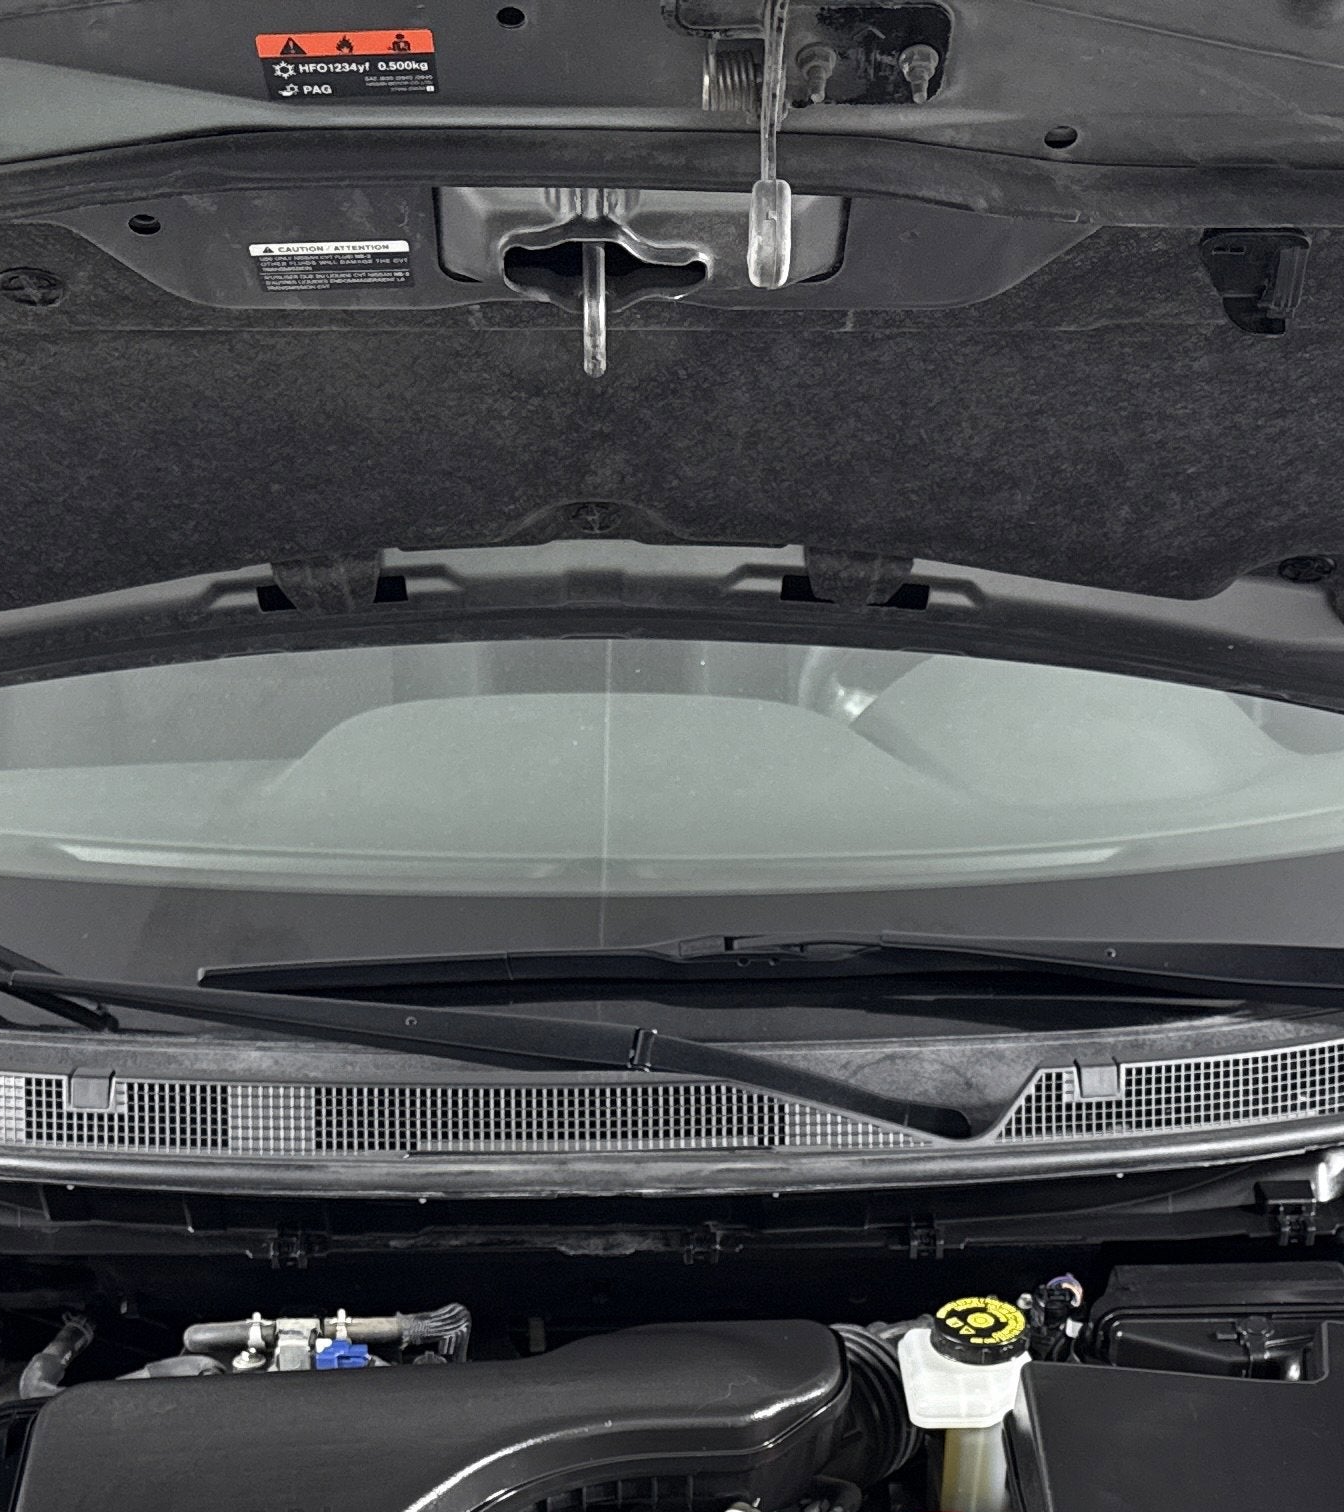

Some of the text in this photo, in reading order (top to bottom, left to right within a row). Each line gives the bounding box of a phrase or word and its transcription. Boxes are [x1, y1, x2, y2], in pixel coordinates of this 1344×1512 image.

[298, 61, 429, 73] HFO1234yf 0.500kg
[302, 85, 333, 95] PAG
[278, 245, 324, 253] CAUTION
[334, 244, 389, 252] ATTENTION
